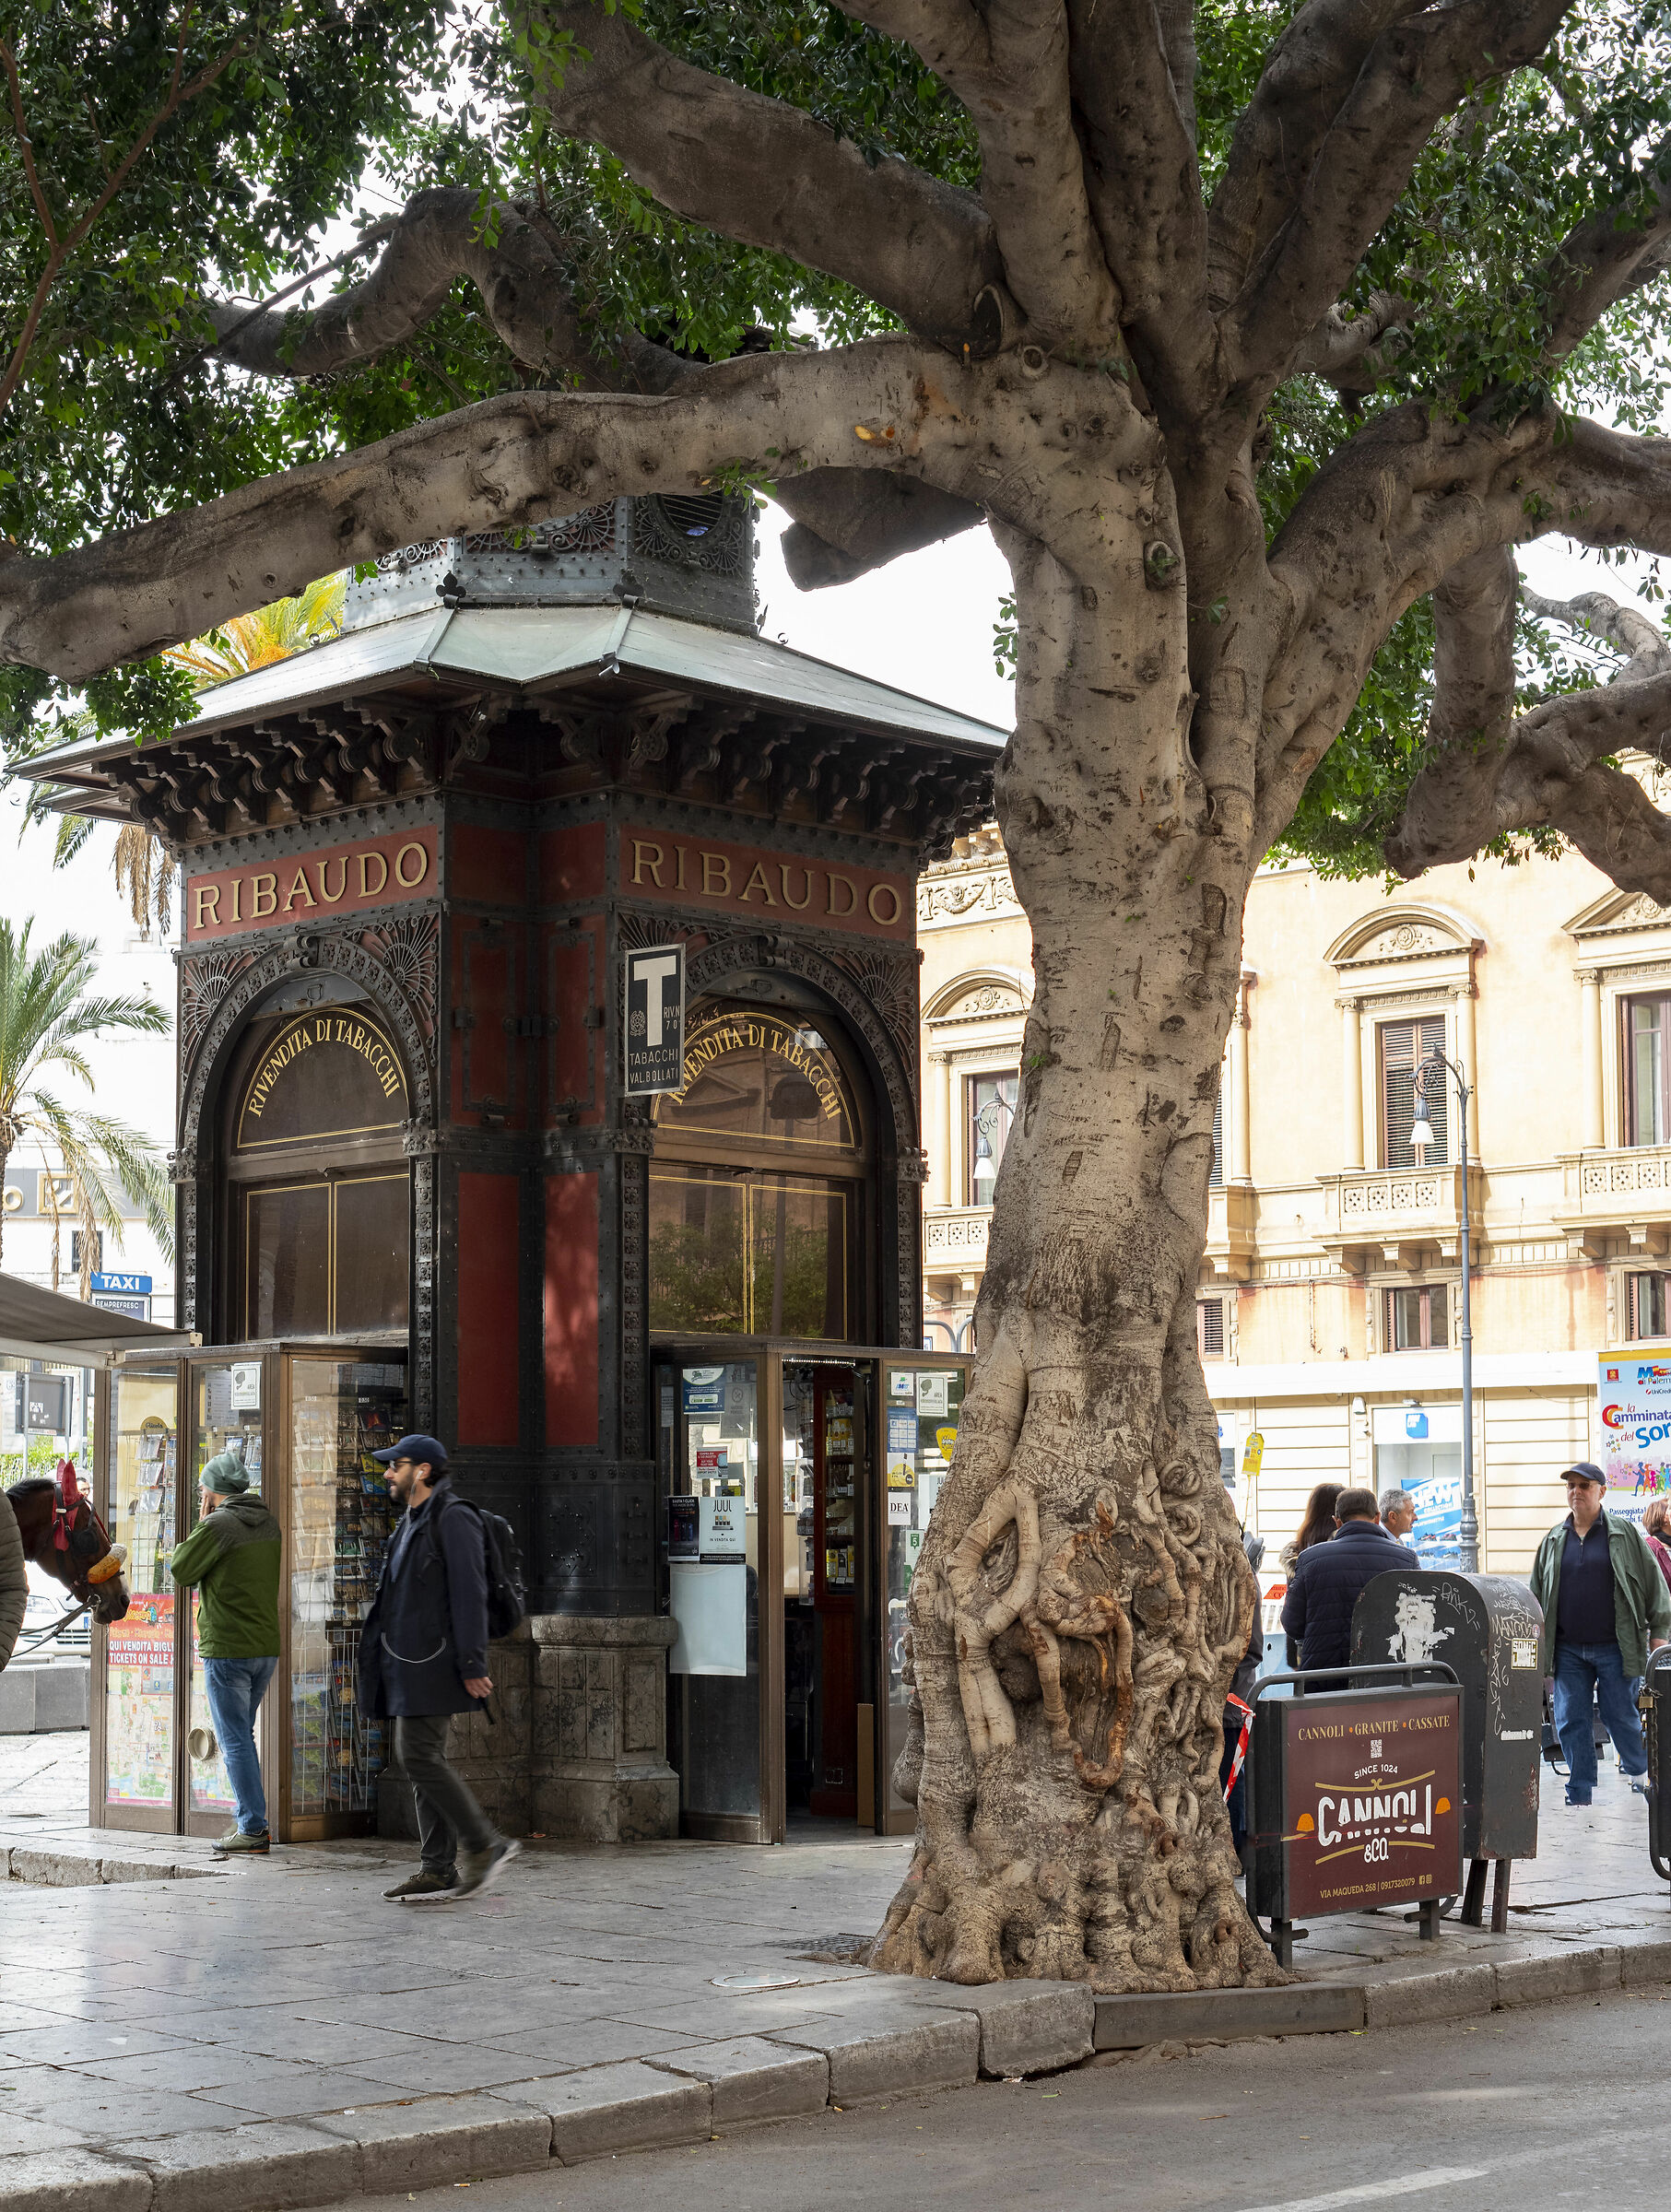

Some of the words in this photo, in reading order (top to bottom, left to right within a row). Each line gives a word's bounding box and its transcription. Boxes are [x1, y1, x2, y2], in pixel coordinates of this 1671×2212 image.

[193, 841, 428, 930] RIBAUDO
[629, 839, 902, 925] RIBAUDO
[633, 955, 677, 1047] T
[629, 1048, 678, 1066] TABACCHI
[248, 1028, 313, 1118] RIVENDITA
[315, 1018, 332, 1042] DI
[335, 1019, 401, 1099] TABACCHI
[748, 1023, 766, 1048] DI
[770, 1030, 841, 1120] TABACCHI
[100, 1275, 140, 1290] TAXI
[1627, 1403, 1636, 1414] la
[1620, 1431, 1634, 1442] del
[712, 1499, 733, 1512] JUUL
[889, 1502, 910, 1512] DEA
[1608, 1507, 1644, 1517] Passeggiata
[109, 1641, 122, 1652] QUI
[123, 1641, 152, 1653] VENDITA
[109, 1653, 137, 1665] TICKETS
[137, 1653, 148, 1665] ON
[149, 1653, 169, 1665] SALE
[1298, 1724, 1345, 1741] CANNOLI
[1354, 1720, 1399, 1736] GRANITE
[1408, 1714, 1450, 1731] CASSATE
[1353, 1764, 1379, 1780] SINCE
[1381, 1763, 1398, 1774] 1024
[1320, 1888, 1332, 1899] VIA
[1332, 1883, 1365, 1898] MAQUEDA
[1380, 1877, 1416, 1890] 0917320079
